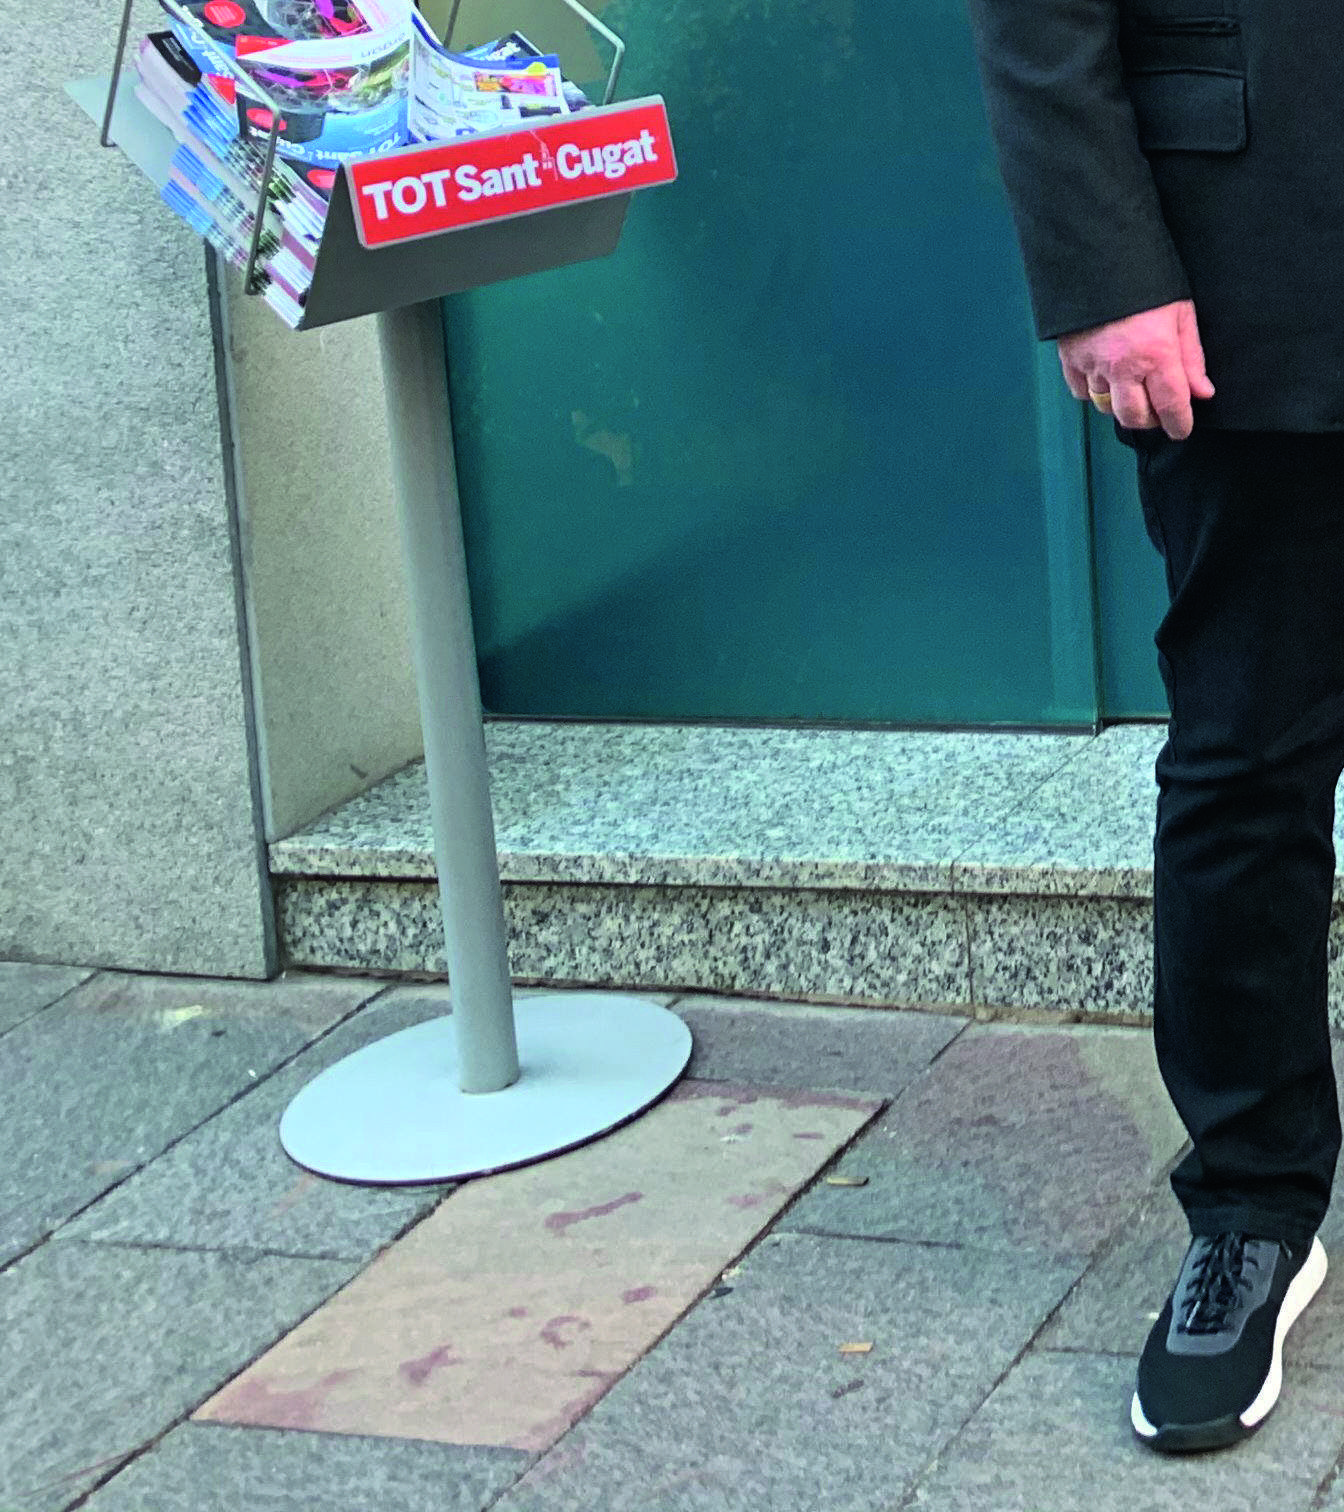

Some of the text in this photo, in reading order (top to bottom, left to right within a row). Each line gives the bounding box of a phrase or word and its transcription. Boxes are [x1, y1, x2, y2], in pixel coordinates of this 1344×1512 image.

[363, 129, 658, 221] TOT Sant Cugat
